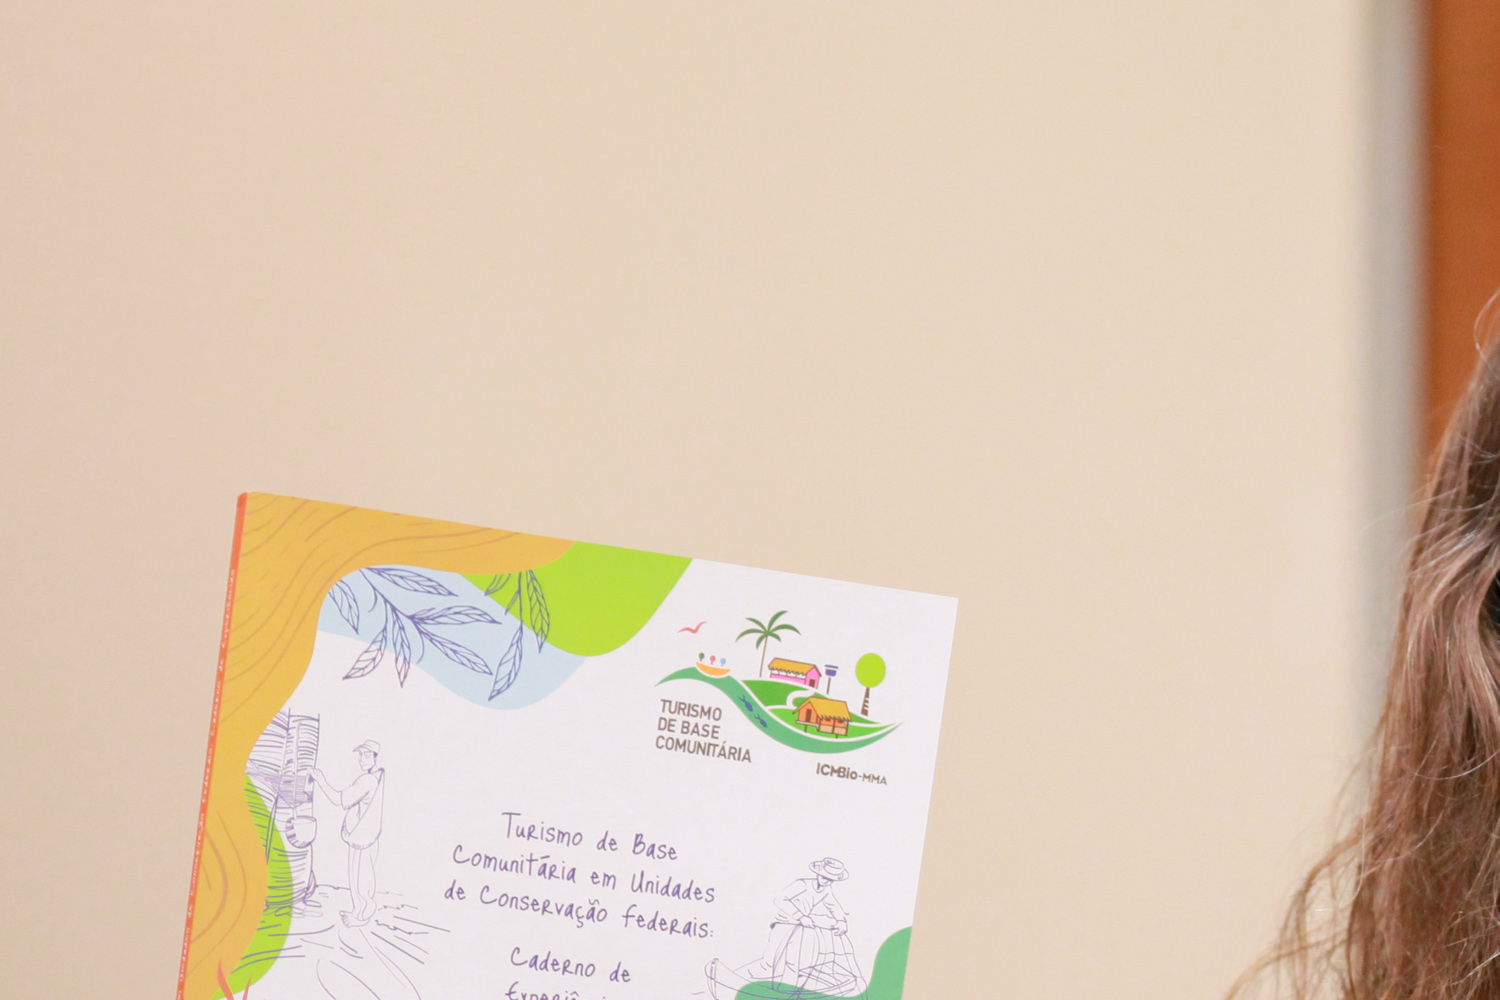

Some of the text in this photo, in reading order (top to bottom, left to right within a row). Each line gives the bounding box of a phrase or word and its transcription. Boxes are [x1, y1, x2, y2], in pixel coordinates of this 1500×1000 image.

[657, 716, 721, 740] DE BASE
[660, 699, 723, 722] TURISMO
[655, 735, 752, 763] COMUNITÁRIA
[501, 811, 678, 861] Turismo de Base
[452, 844, 715, 903] Comunitária em Unidades
[443, 878, 467, 901] de
[479, 885, 608, 929] Conservação
[510, 946, 631, 983] Caderno de
